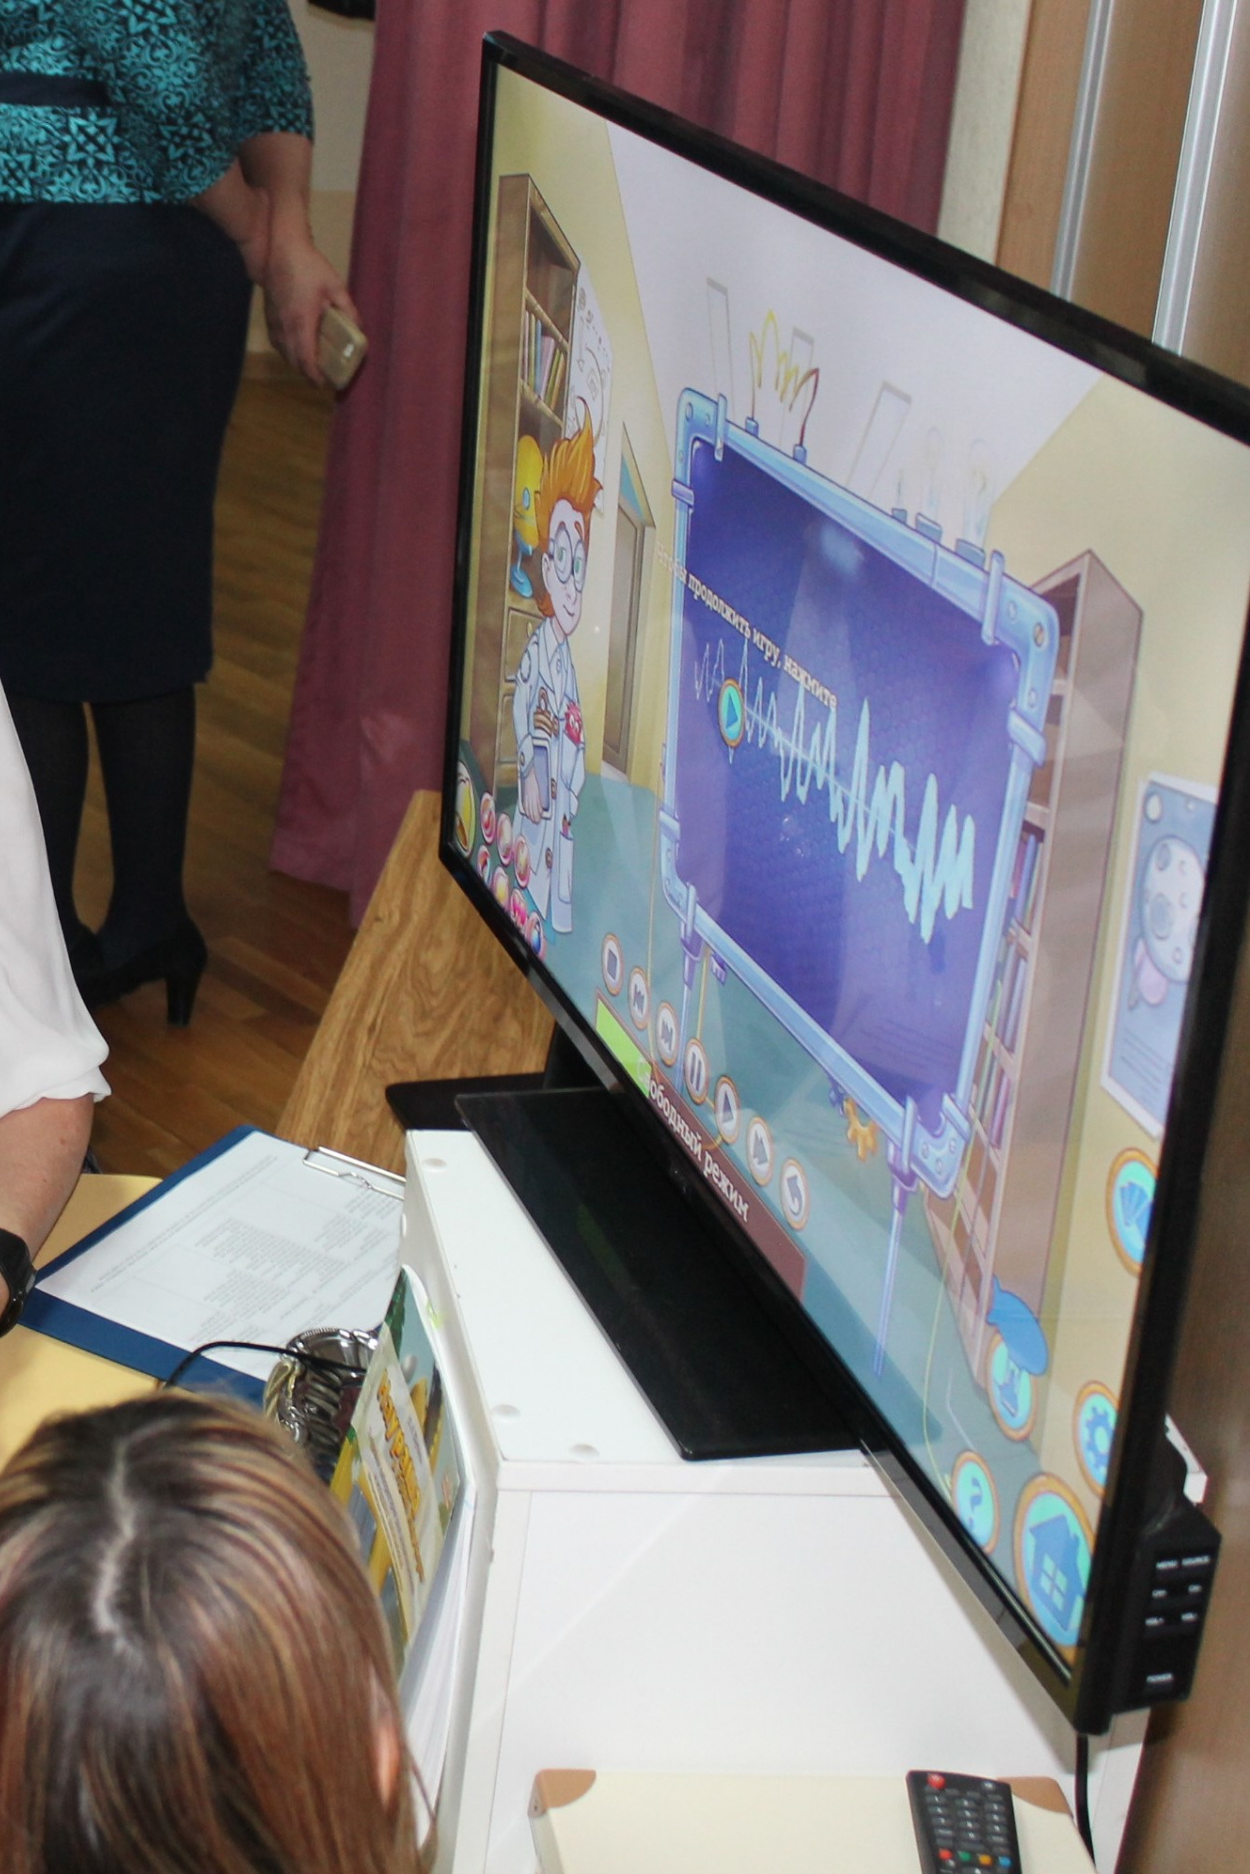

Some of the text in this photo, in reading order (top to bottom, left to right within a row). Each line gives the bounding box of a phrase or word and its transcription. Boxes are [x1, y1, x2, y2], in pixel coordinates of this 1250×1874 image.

[688, 573, 751, 640] продолжить
[752, 627, 781, 669] игру,
[783, 653, 838, 708] нажмите
[637, 1057, 750, 1223] Свободный режим
